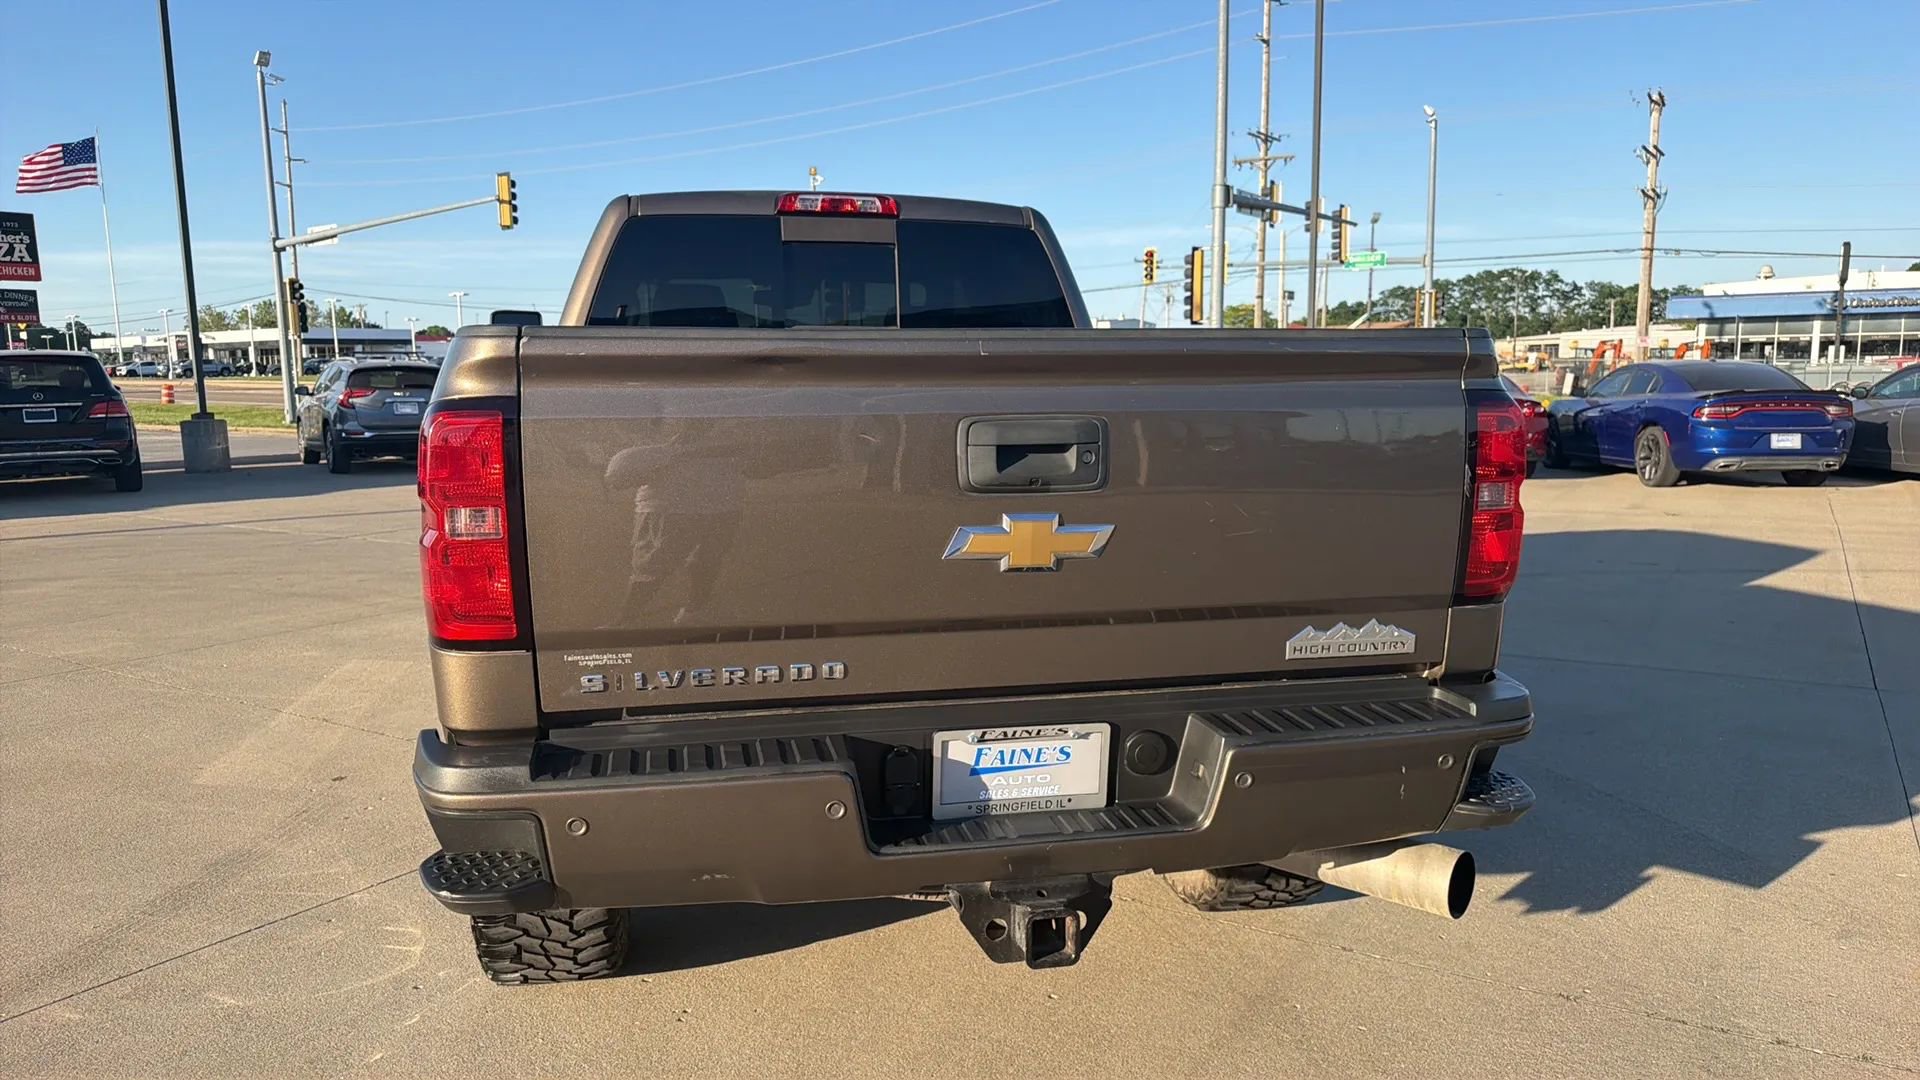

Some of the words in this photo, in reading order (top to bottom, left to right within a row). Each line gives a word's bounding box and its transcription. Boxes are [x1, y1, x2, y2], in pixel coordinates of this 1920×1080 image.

[1293, 644, 1332, 655] HIGH
[1338, 640, 1410, 653] COUNTRY
[580, 661, 846, 694] SILVERADO
[980, 727, 1069, 740] FAINE'S
[973, 745, 1072, 768] FAINE'S
[990, 774, 1051, 786] AUTO
[979, 787, 1009, 800] SALES
[1021, 785, 1060, 798] SERVICE
[975, 800, 1053, 815] SPRINGFIELD
[1056, 799, 1066, 808] IL
